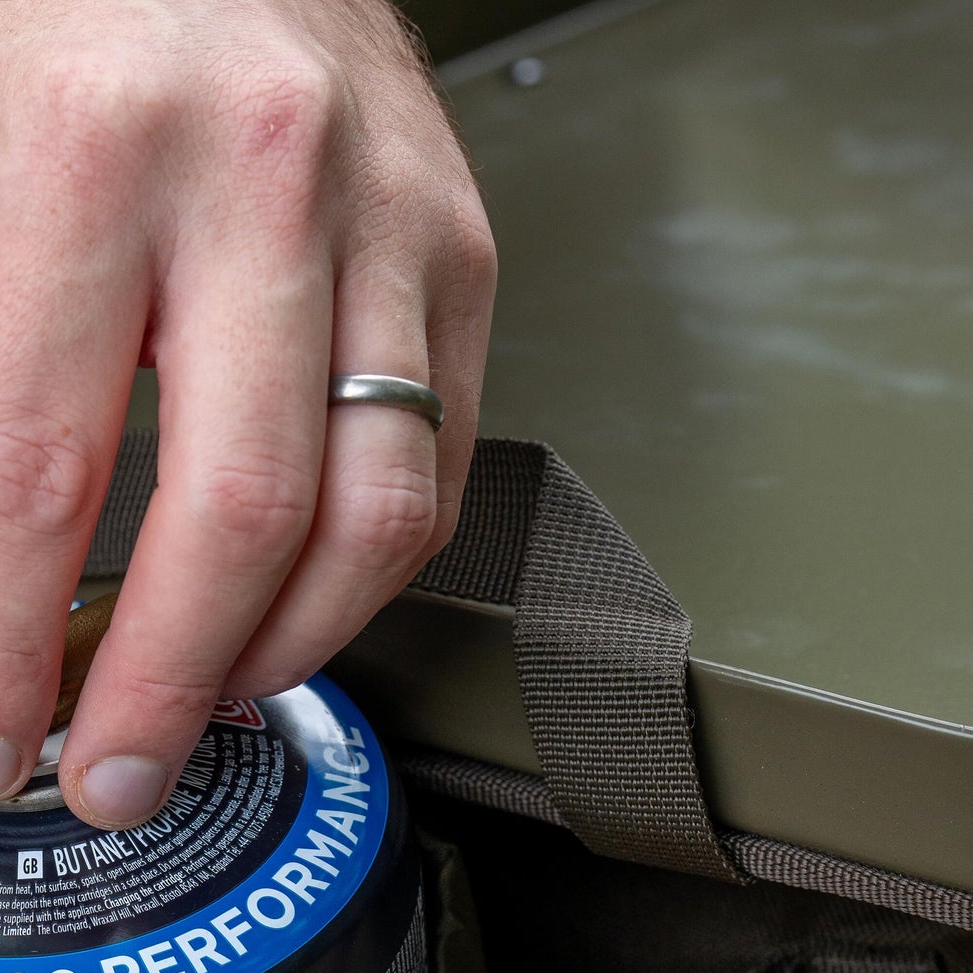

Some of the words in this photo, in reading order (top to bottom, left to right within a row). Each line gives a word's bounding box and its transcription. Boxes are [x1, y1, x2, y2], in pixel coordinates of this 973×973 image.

[4, 912, 34, 926] supplied
[36, 911, 52, 922] with
[54, 910, 66, 920] the
[68, 905, 105, 919] appliance.
[104, 892, 141, 909] Changing
[139, 887, 154, 897] the
[182, 856, 209, 874] Perform
[204, 848, 219, 858] this
[216, 828, 240, 850] operation
[11, 898, 38, 912] deposit
[40, 897, 51, 908] the
[53, 896, 75, 907] empty
[77, 887, 113, 902] cartridges
[111, 883, 121, 893] in
[126, 875, 142, 888] safe
[140, 869, 162, 884] place.
[157, 863, 171, 872] Do
[169, 856, 182, 867] not
[179, 827, 220, 862] puncture/pierce
[214, 820, 225, 828] or
[16, 884, 33, 895] heat,
[35, 883, 47, 893] hot
[49, 880, 80, 892] surfaces,
[81, 873, 107, 888] sparks,
[107, 868, 125, 880] open
[122, 855, 147, 872] flames
[145, 849, 159, 862] and
[157, 842, 174, 855] other
[169, 828, 194, 846] ignition
[52, 788, 202, 878] BUTANE/PROPANE
[3, 925, 31, 936] Limited
[37, 924, 50, 935] The
[52, 918, 91, 933] Courtyard,
[90, 911, 118, 926] Wraxall
[117, 907, 135, 919] Hill,
[132, 897, 163, 914] Wraxall,
[159, 886, 183, 903] Bristol
[208, 853, 233, 874] England
